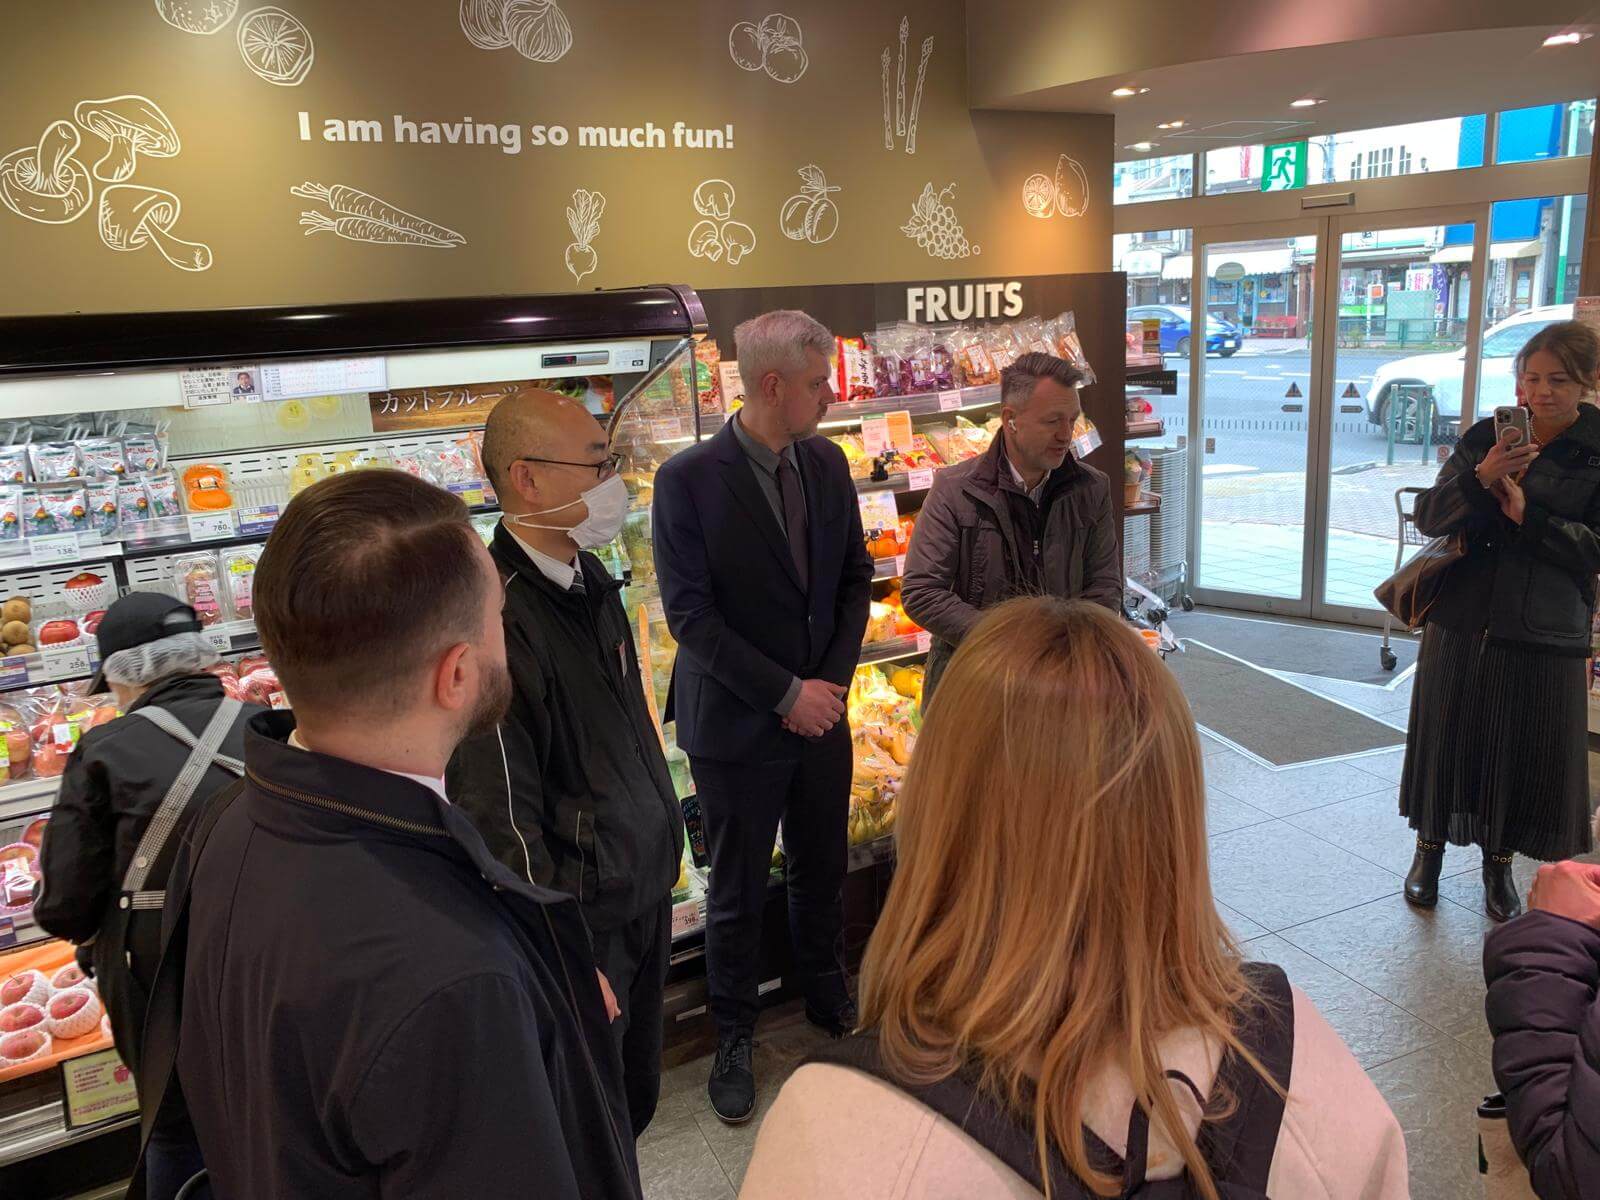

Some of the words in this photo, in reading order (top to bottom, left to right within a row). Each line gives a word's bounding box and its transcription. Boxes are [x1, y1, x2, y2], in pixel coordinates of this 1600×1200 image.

[298, 111, 311, 141] I
[322, 118, 383, 142] am
[393, 114, 521, 154] having
[531, 124, 569, 146] so
[578, 122, 666, 149] much
[672, 121, 735, 149] fun!
[906, 281, 1023, 323] FRUITS
